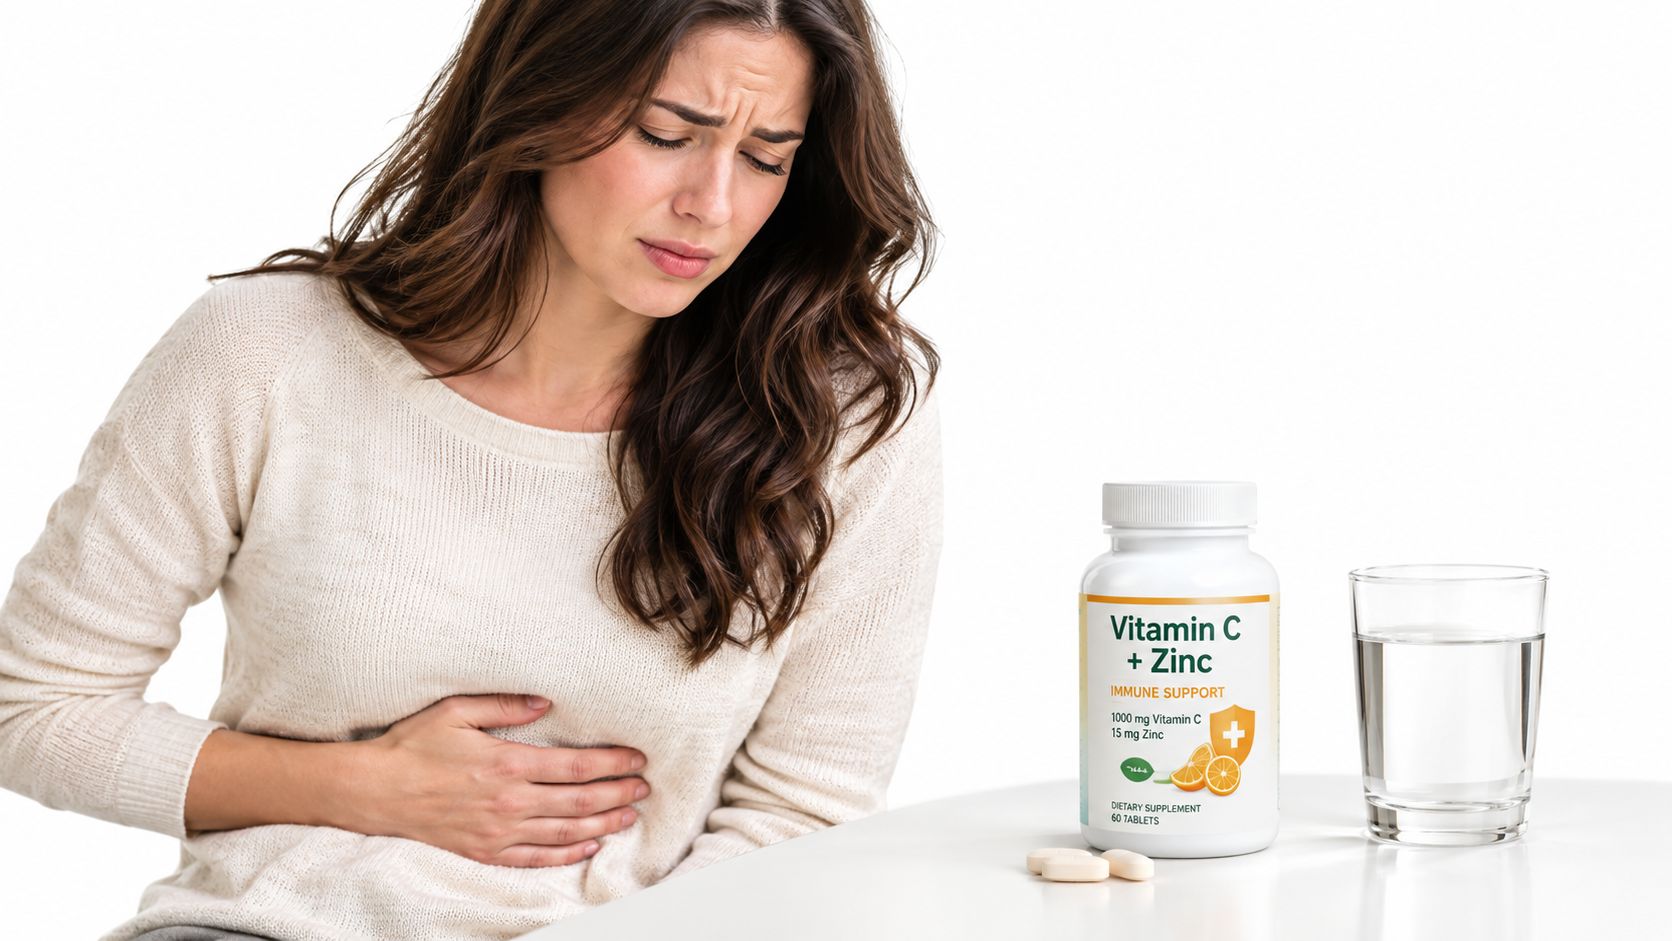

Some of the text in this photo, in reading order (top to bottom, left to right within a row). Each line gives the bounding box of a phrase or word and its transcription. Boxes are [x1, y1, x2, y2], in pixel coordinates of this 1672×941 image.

[1110, 614, 1241, 641] Vitamin C
[1127, 647, 1213, 673] + Zinc
[1110, 685, 1226, 699] IMMUNE SUPPORT
[1111, 712, 1202, 727] 1000 mg Vitamin C
[1111, 727, 1164, 742] 15 mg Zinc
[1111, 801, 1202, 813] DIETARY SUPPLEMENT
[1111, 813, 1122, 823] 60
